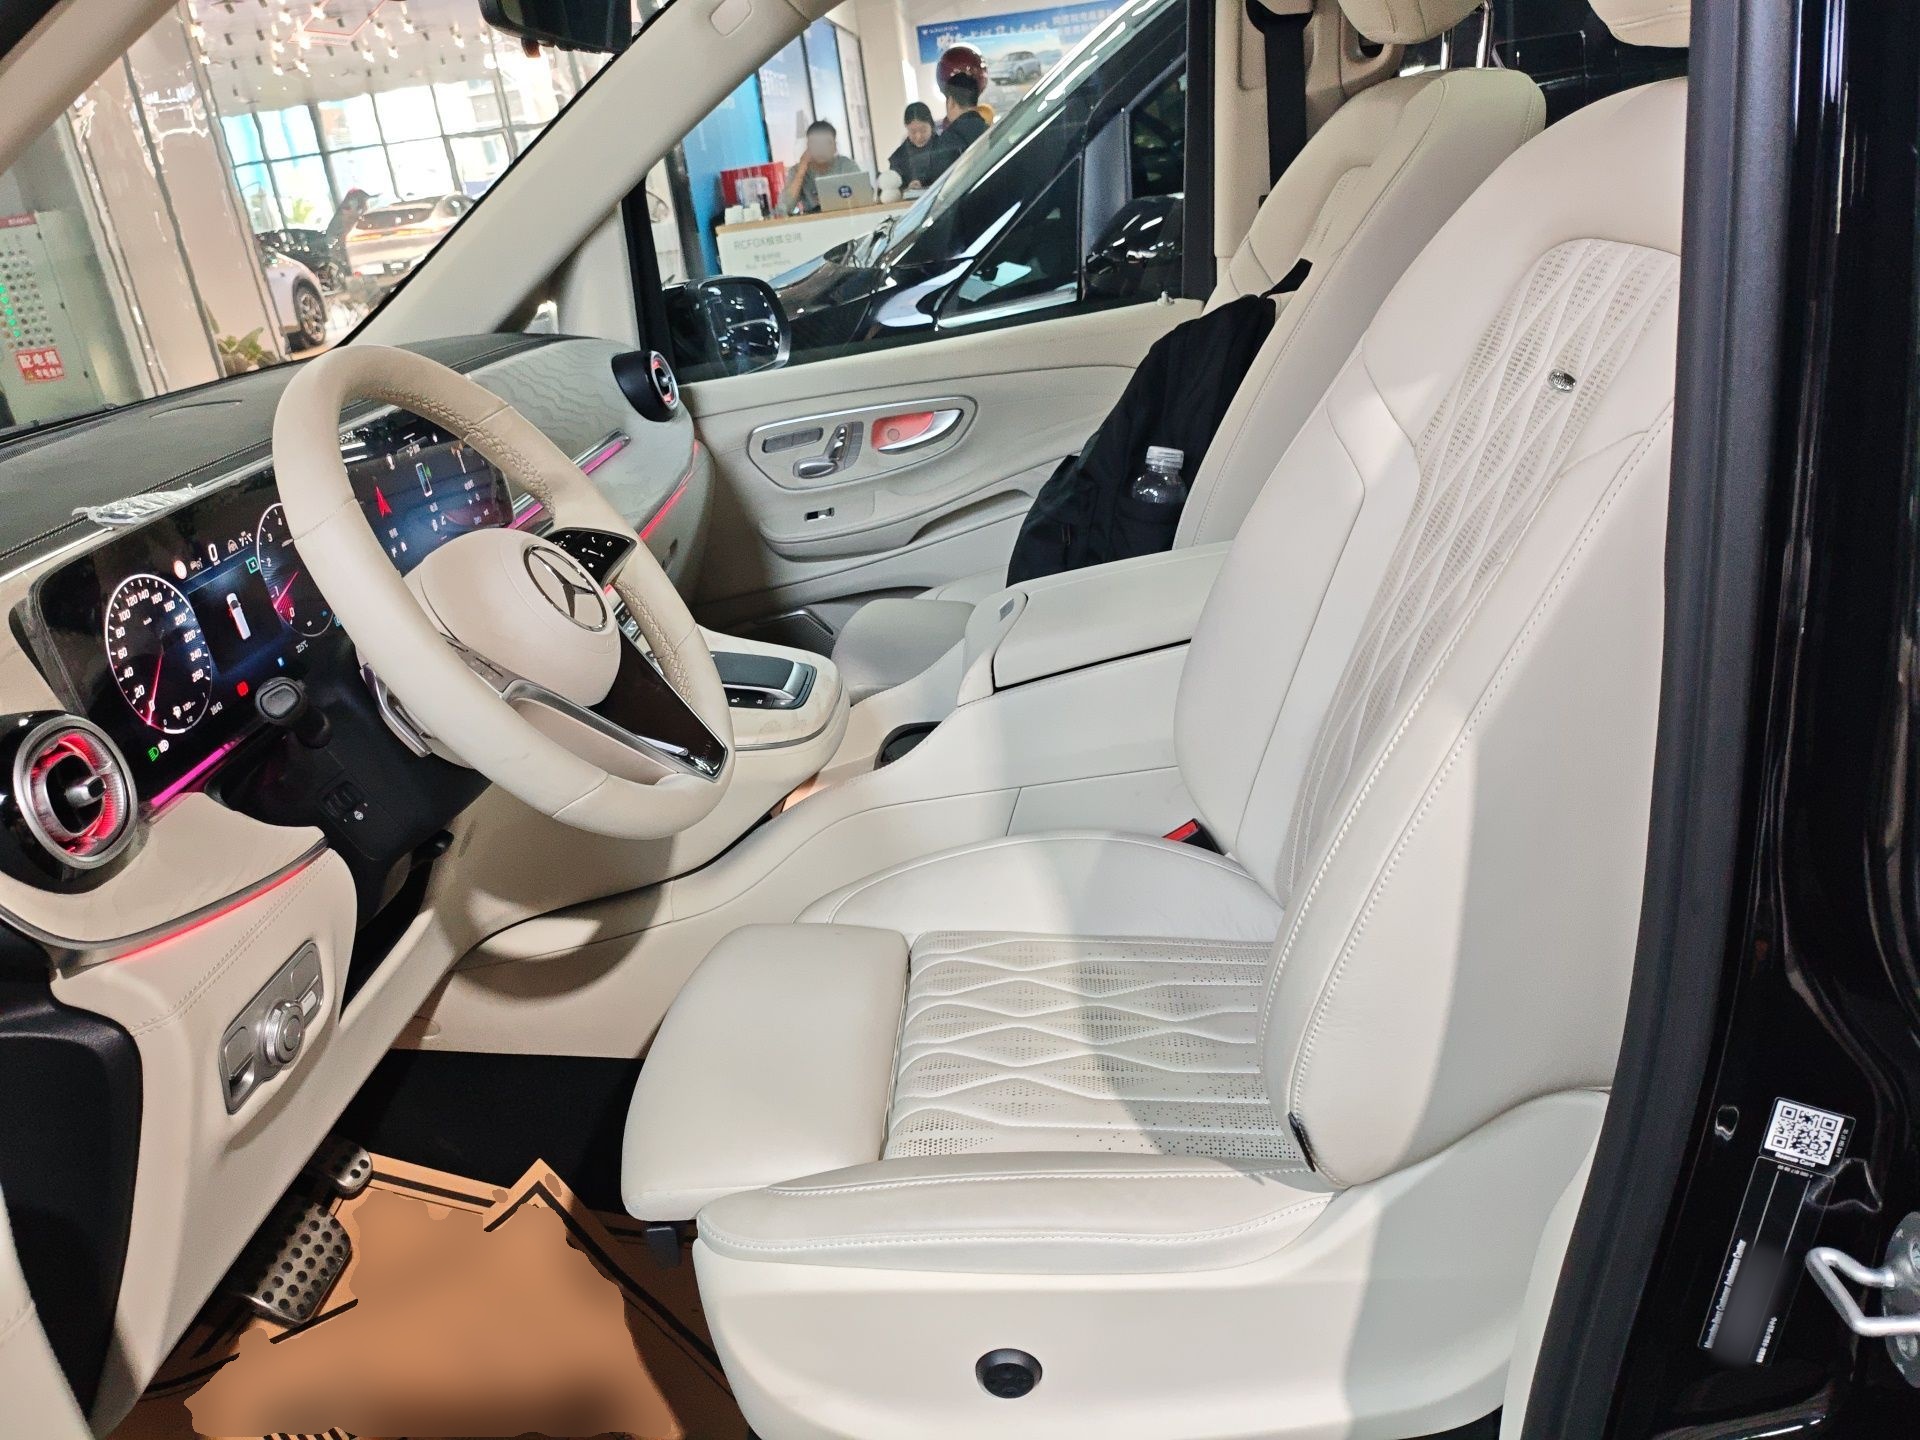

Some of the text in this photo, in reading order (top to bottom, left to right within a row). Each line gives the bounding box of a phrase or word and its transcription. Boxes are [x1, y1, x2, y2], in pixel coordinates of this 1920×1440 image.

[207, 543, 219, 562] 0
[266, 557, 272, 568] 2
[126, 594, 139, 607] 120
[138, 588, 150, 602] 140
[151, 591, 163, 605] 160
[164, 600, 176, 613] 180
[289, 606, 296, 618] 0
[118, 609, 131, 623] 100
[175, 612, 187, 626] 200
[115, 626, 126, 639] 80
[184, 629, 196, 643] 220
[117, 647, 128, 660] 60
[190, 648, 202, 662] 240
[123, 666, 134, 679] 40
[191, 668, 204, 683] 260
[134, 684, 145, 699] 20
